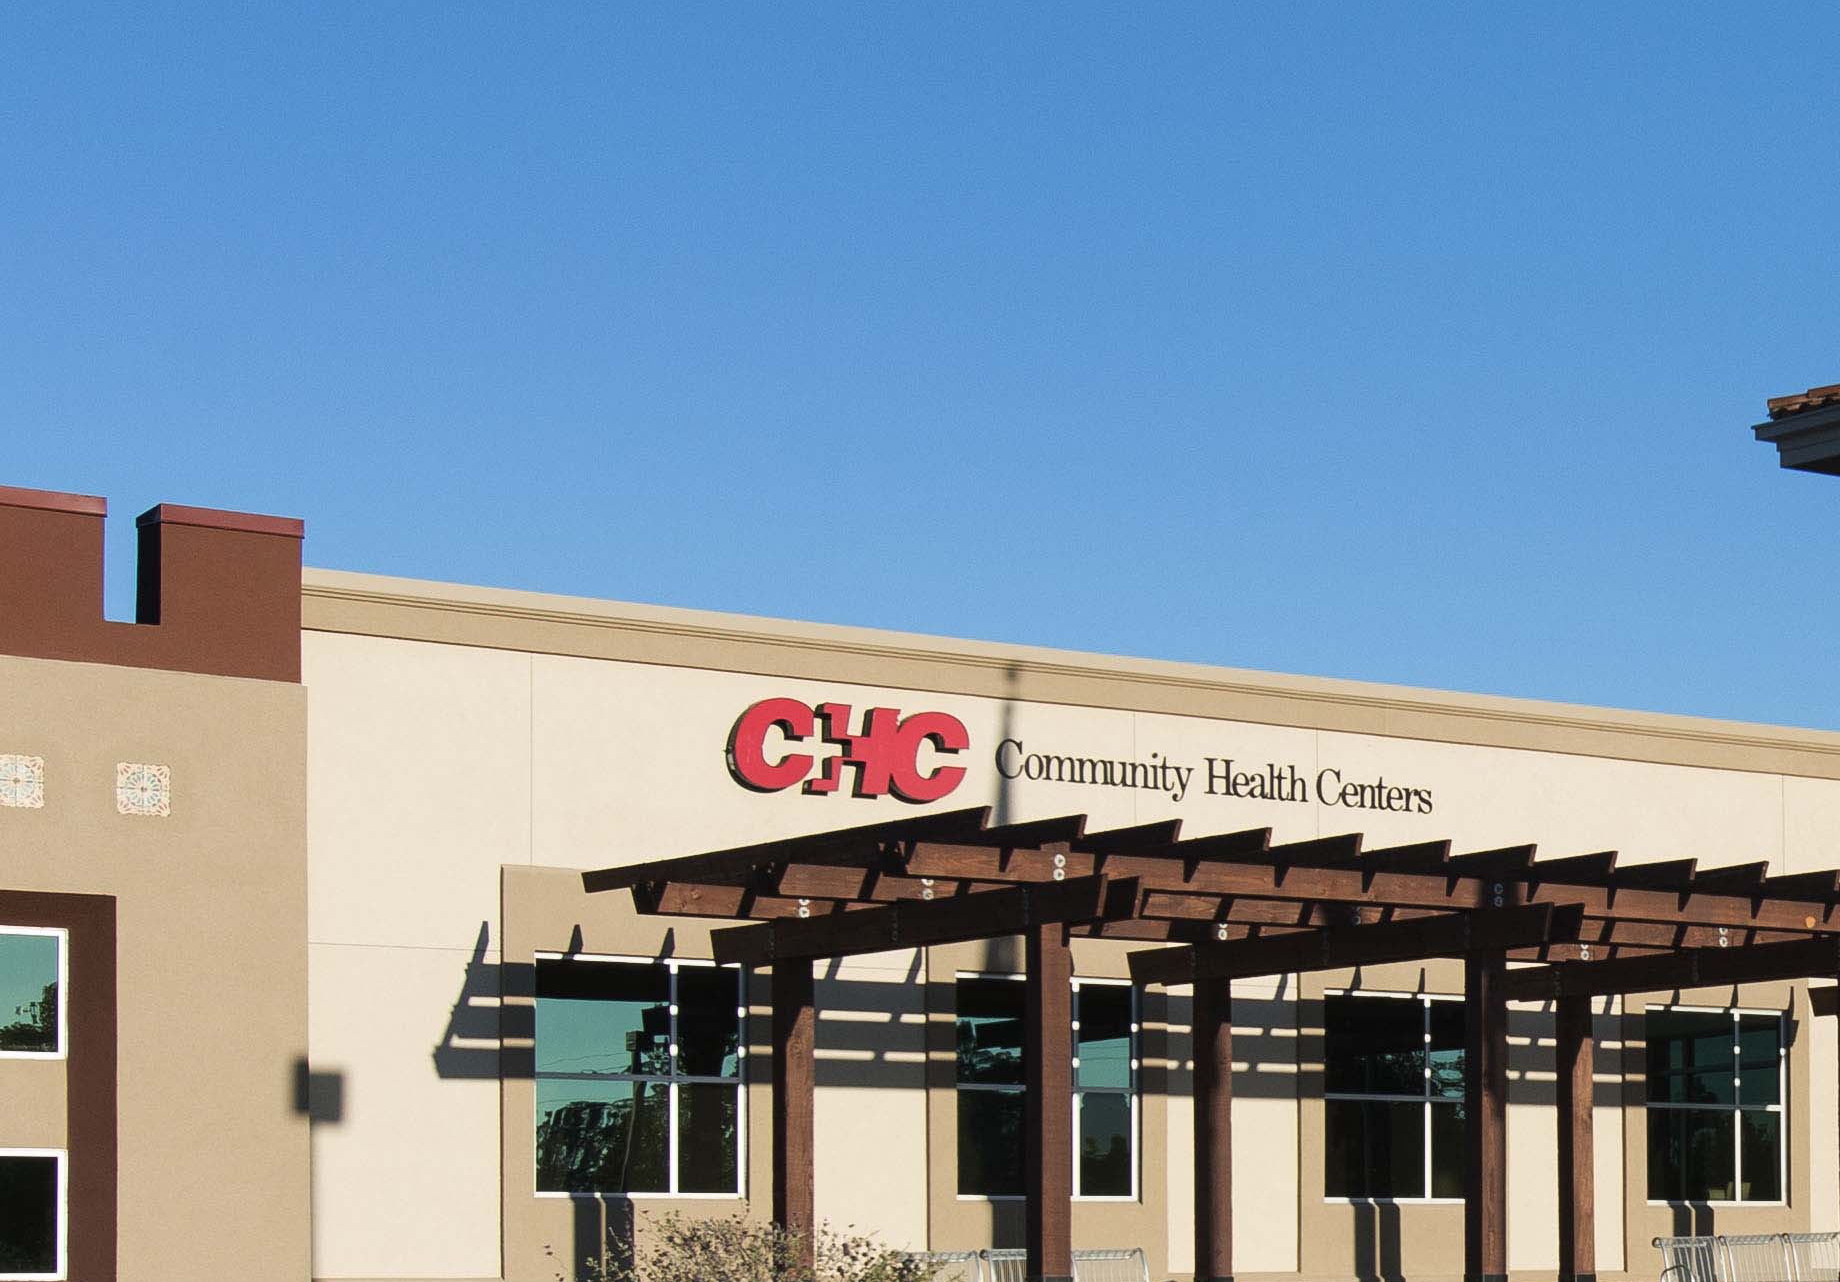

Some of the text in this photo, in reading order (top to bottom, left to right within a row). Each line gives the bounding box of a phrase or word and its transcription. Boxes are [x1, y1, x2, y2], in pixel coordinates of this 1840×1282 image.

[725, 697, 970, 805] CHC
[994, 737, 1433, 815] Community Health Centers
